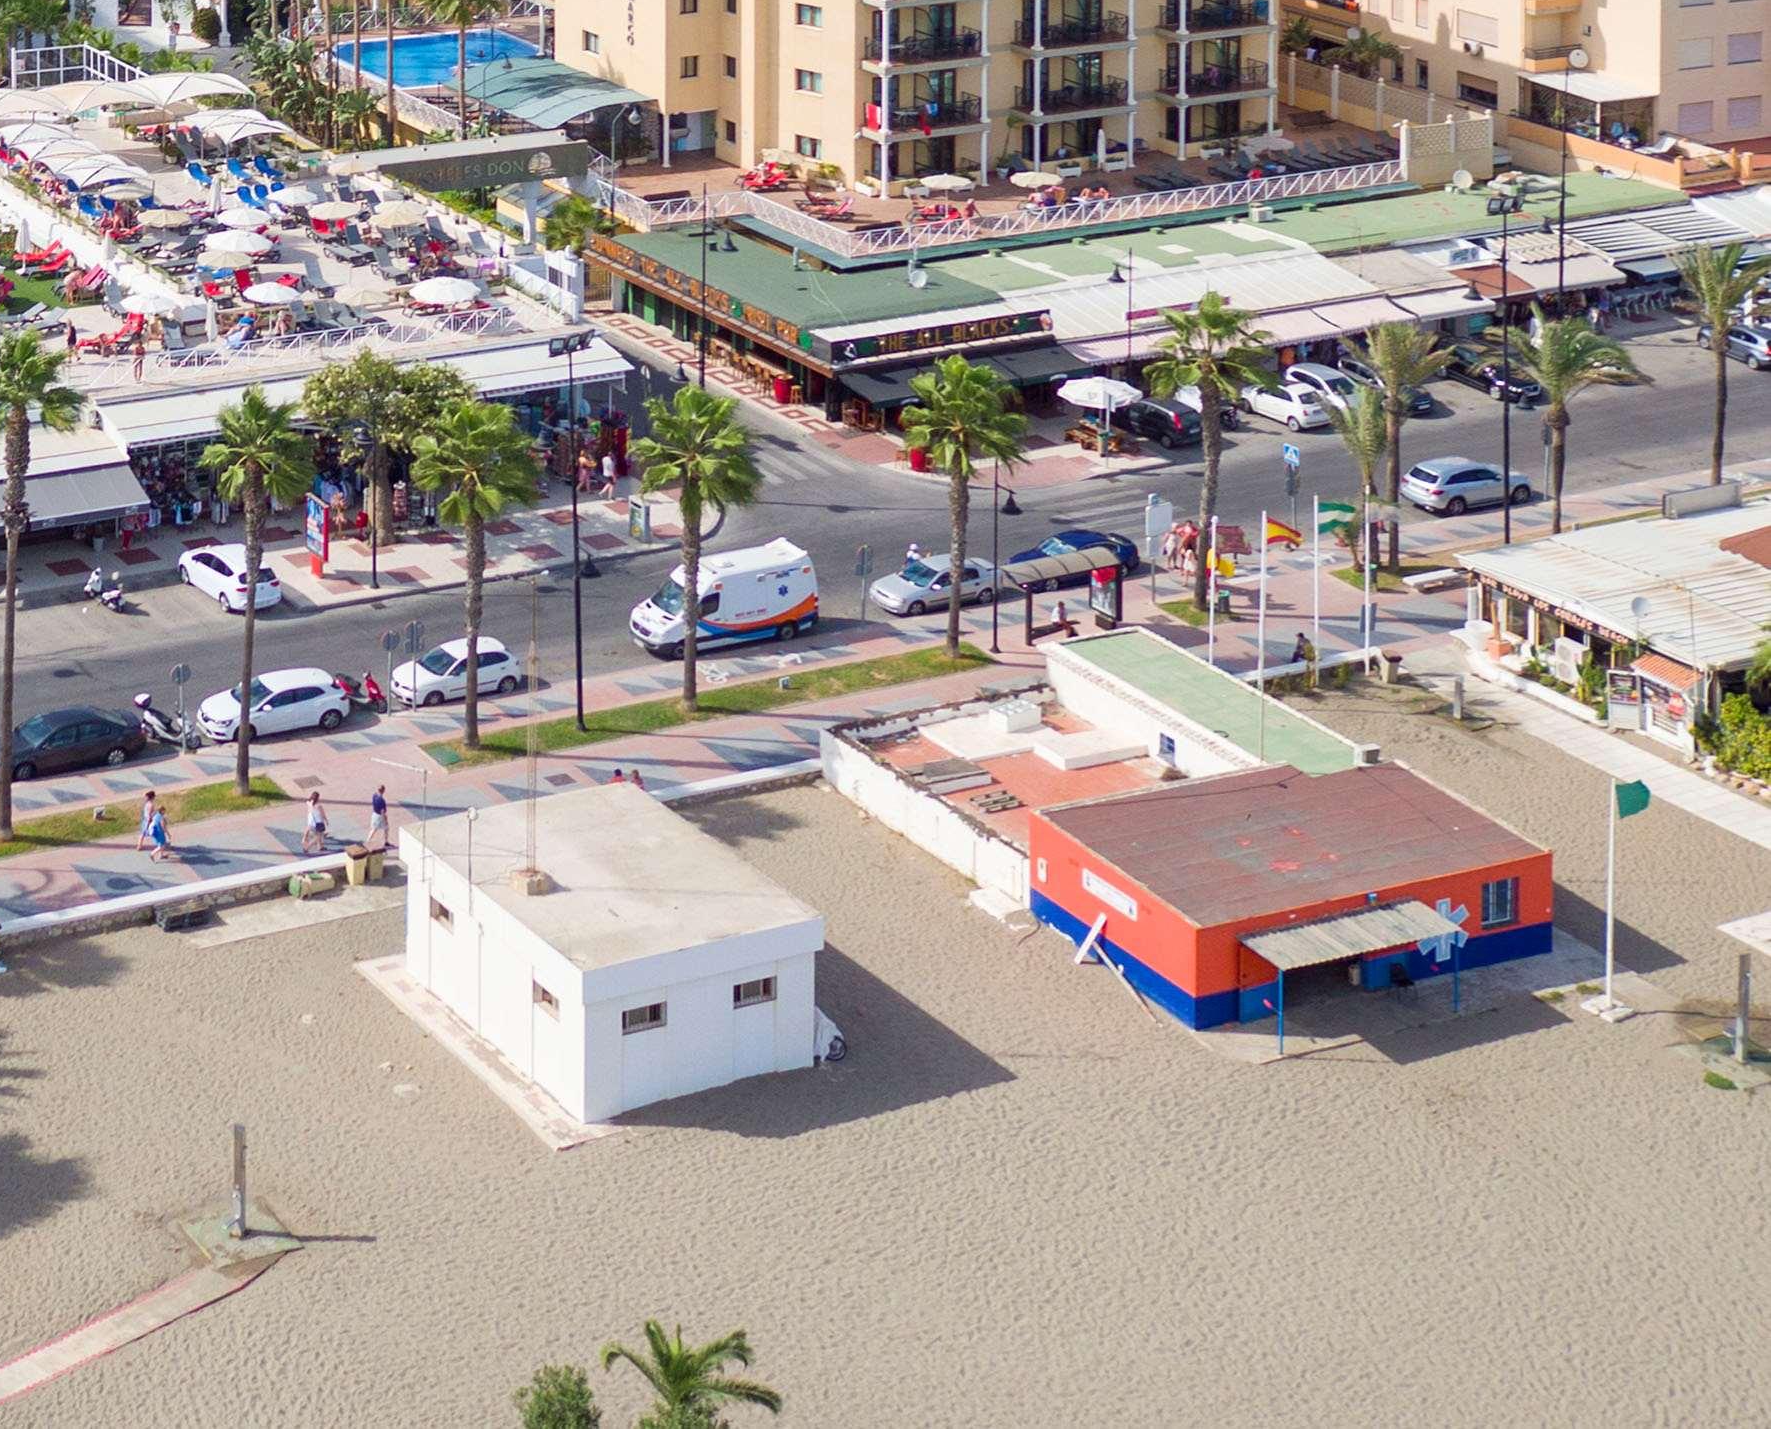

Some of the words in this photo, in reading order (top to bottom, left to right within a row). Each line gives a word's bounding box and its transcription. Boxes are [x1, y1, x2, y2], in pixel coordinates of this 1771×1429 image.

[487, 160, 524, 177] DON
[880, 333, 909, 352] THE
[917, 329, 945, 347] ALL
[953, 318, 1010, 342] BLACKS
